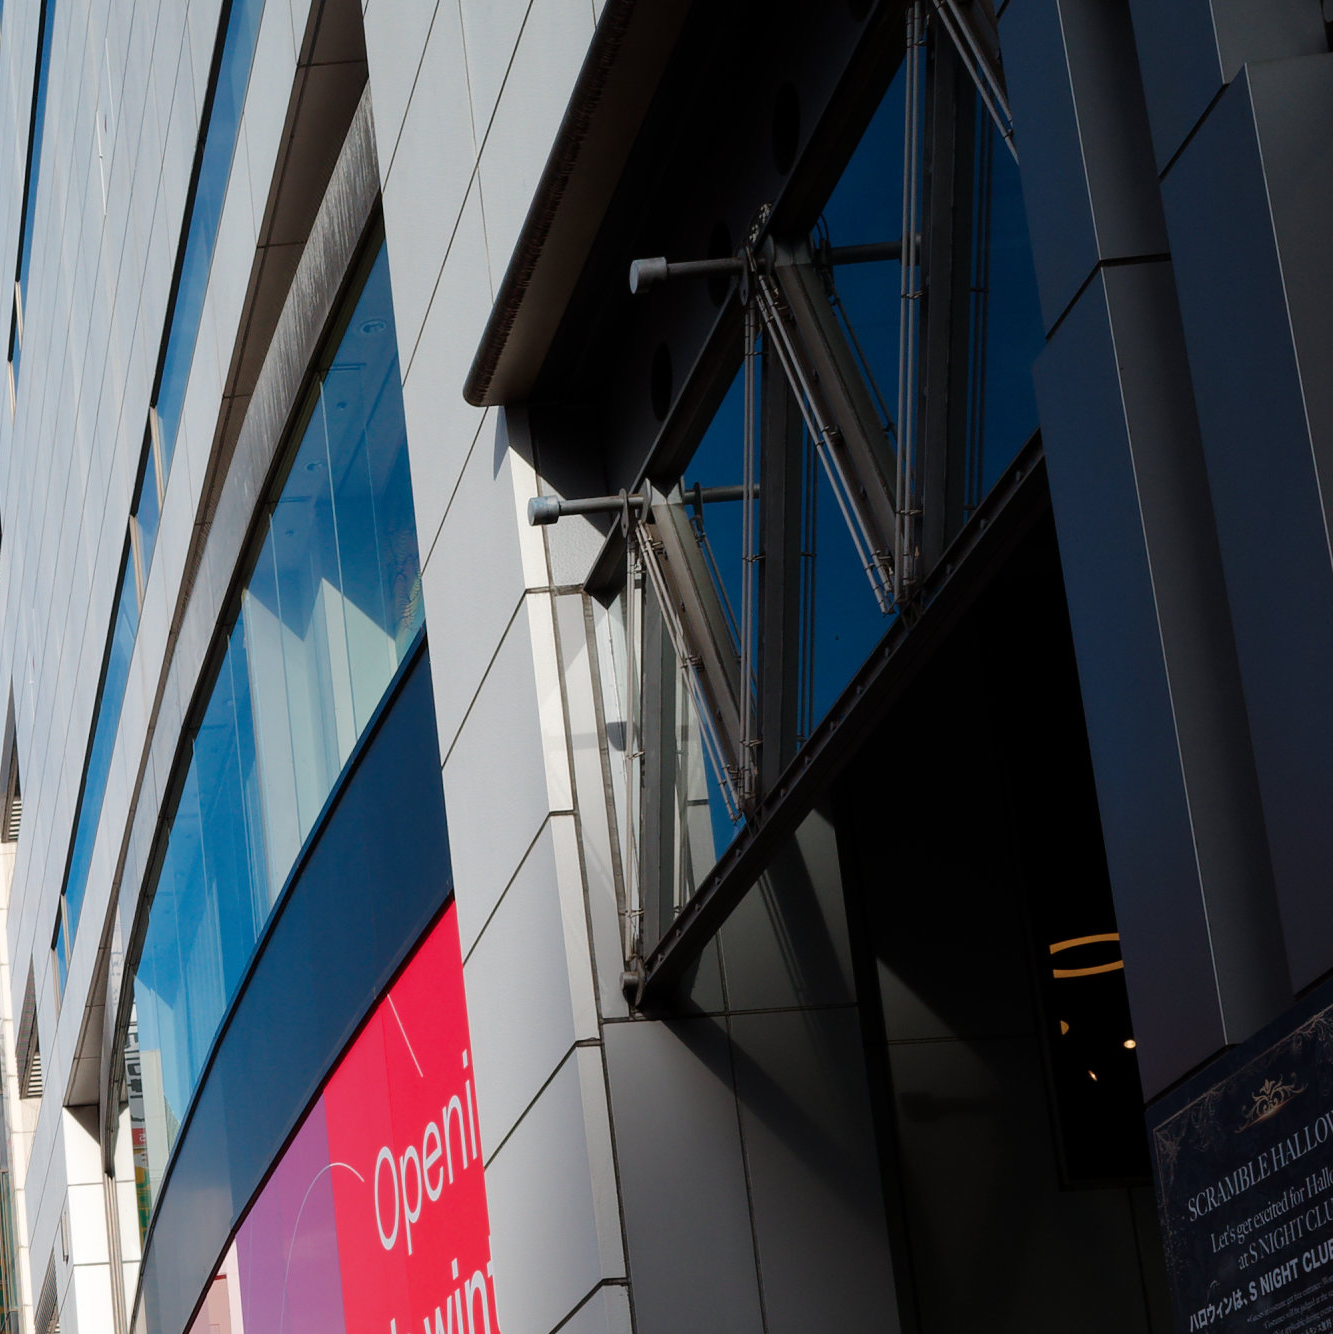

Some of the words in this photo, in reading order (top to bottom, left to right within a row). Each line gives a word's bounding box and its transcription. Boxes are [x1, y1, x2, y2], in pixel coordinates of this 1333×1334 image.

[1187, 1152, 1271, 1222] SCRAMBLE
[1211, 1224, 1236, 1254] Let's
[1236, 1219, 1253, 1245] get
[1253, 1191, 1289, 1228] excited
[1289, 1186, 1306, 1210] for
[1258, 1214, 1304, 1260] NIGHT
[1189, 1288, 1248, 1333] ハロウィンは、
[1248, 1280, 1258, 1301] S
[1259, 1258, 1298, 1296] NIGHT
